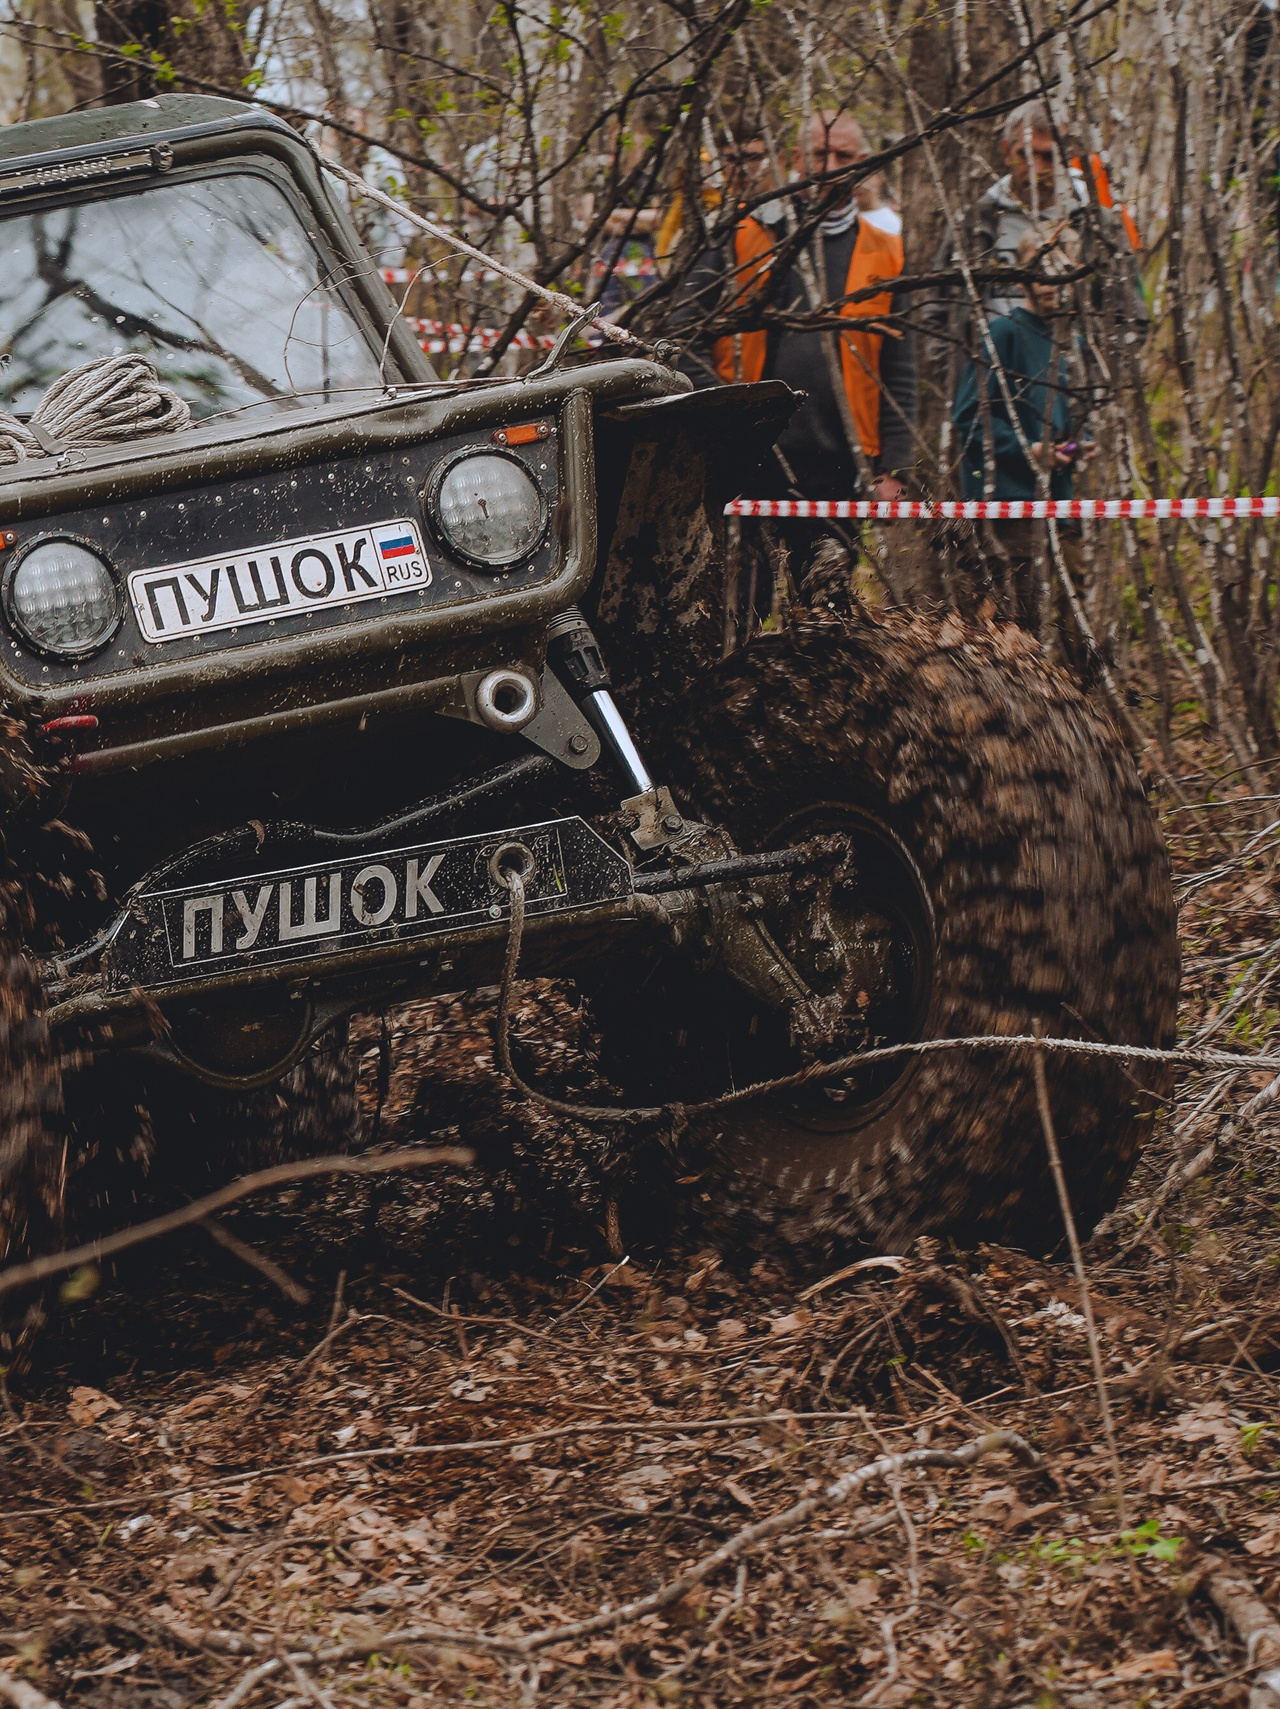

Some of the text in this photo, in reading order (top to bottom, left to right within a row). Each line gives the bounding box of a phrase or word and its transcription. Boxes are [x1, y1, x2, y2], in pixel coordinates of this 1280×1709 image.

[143, 538, 423, 631] ПУШОК RUS
[183, 853, 448, 959] ПУШОК
